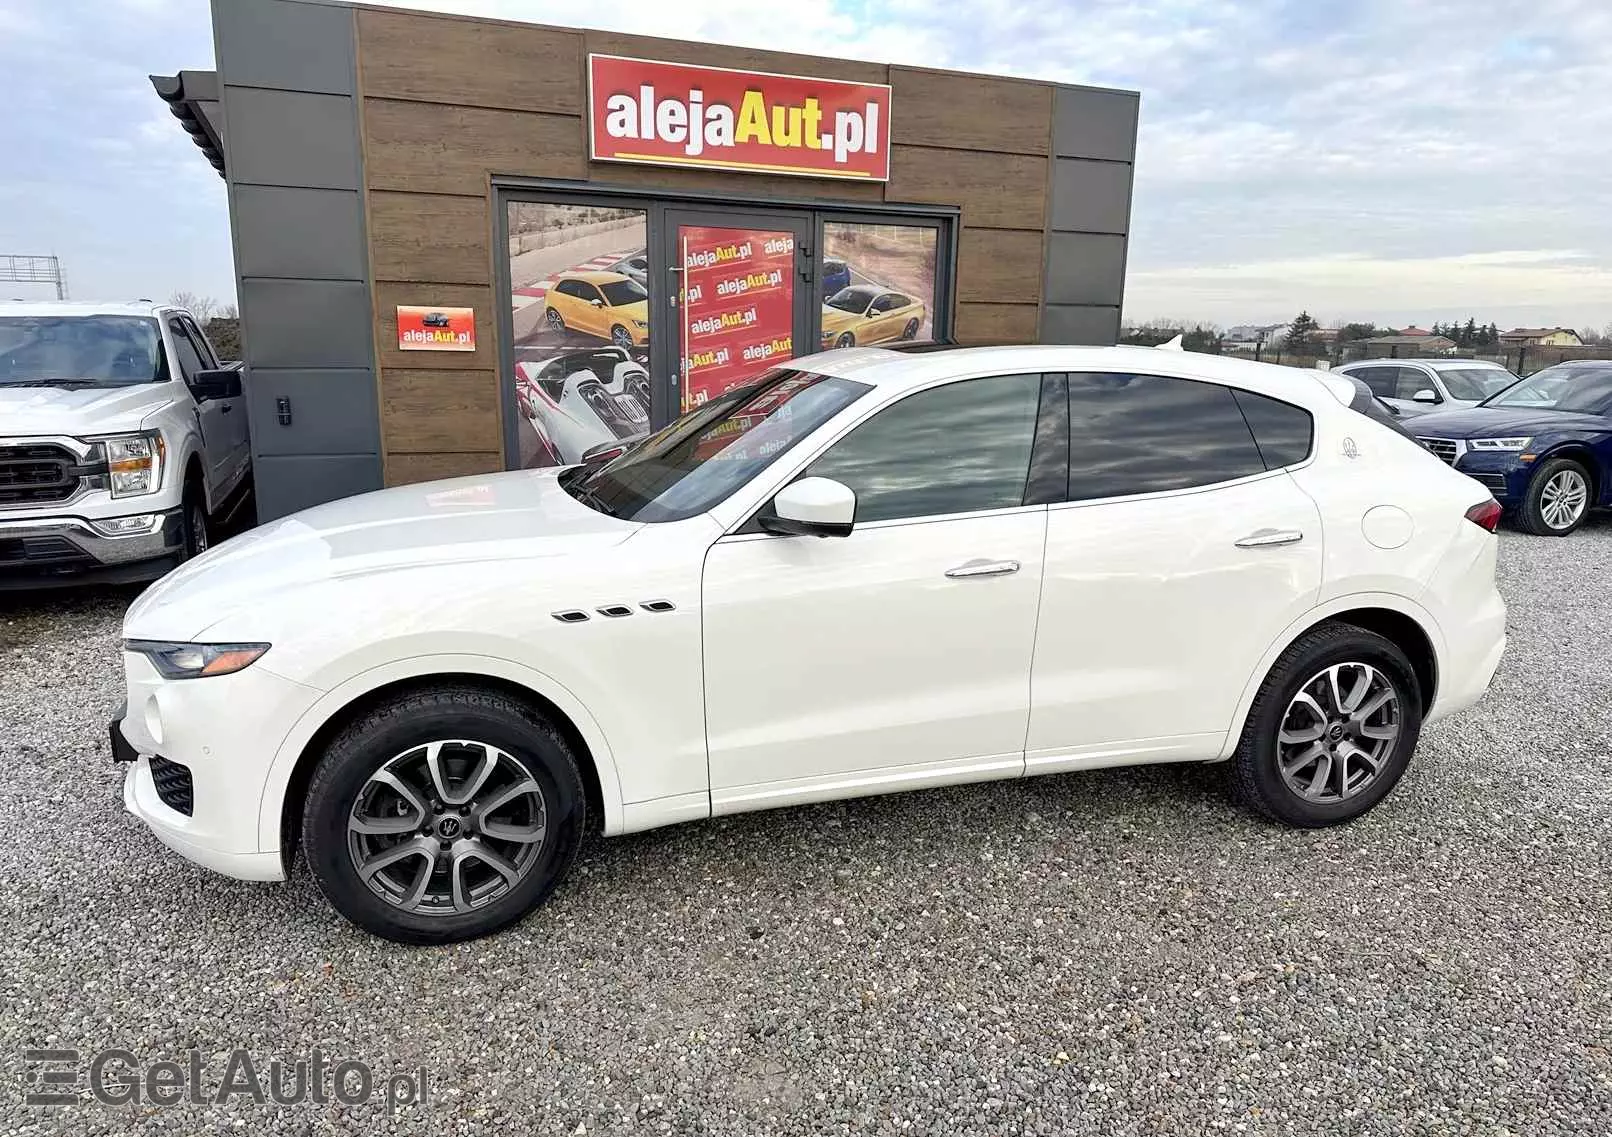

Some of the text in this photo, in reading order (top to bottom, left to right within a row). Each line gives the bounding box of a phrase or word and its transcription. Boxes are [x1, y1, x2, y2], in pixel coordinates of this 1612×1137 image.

[606, 85, 879, 163] alejaAut.pl
[687, 242, 753, 267] alejaAut.pl
[764, 237, 794, 254] aleja
[716, 269, 783, 295] alejaAut.pl
[691, 307, 757, 334] alejaAut.pl
[403, 329, 471, 345] alejaAut.pl
[743, 337, 792, 360] alejaAut
